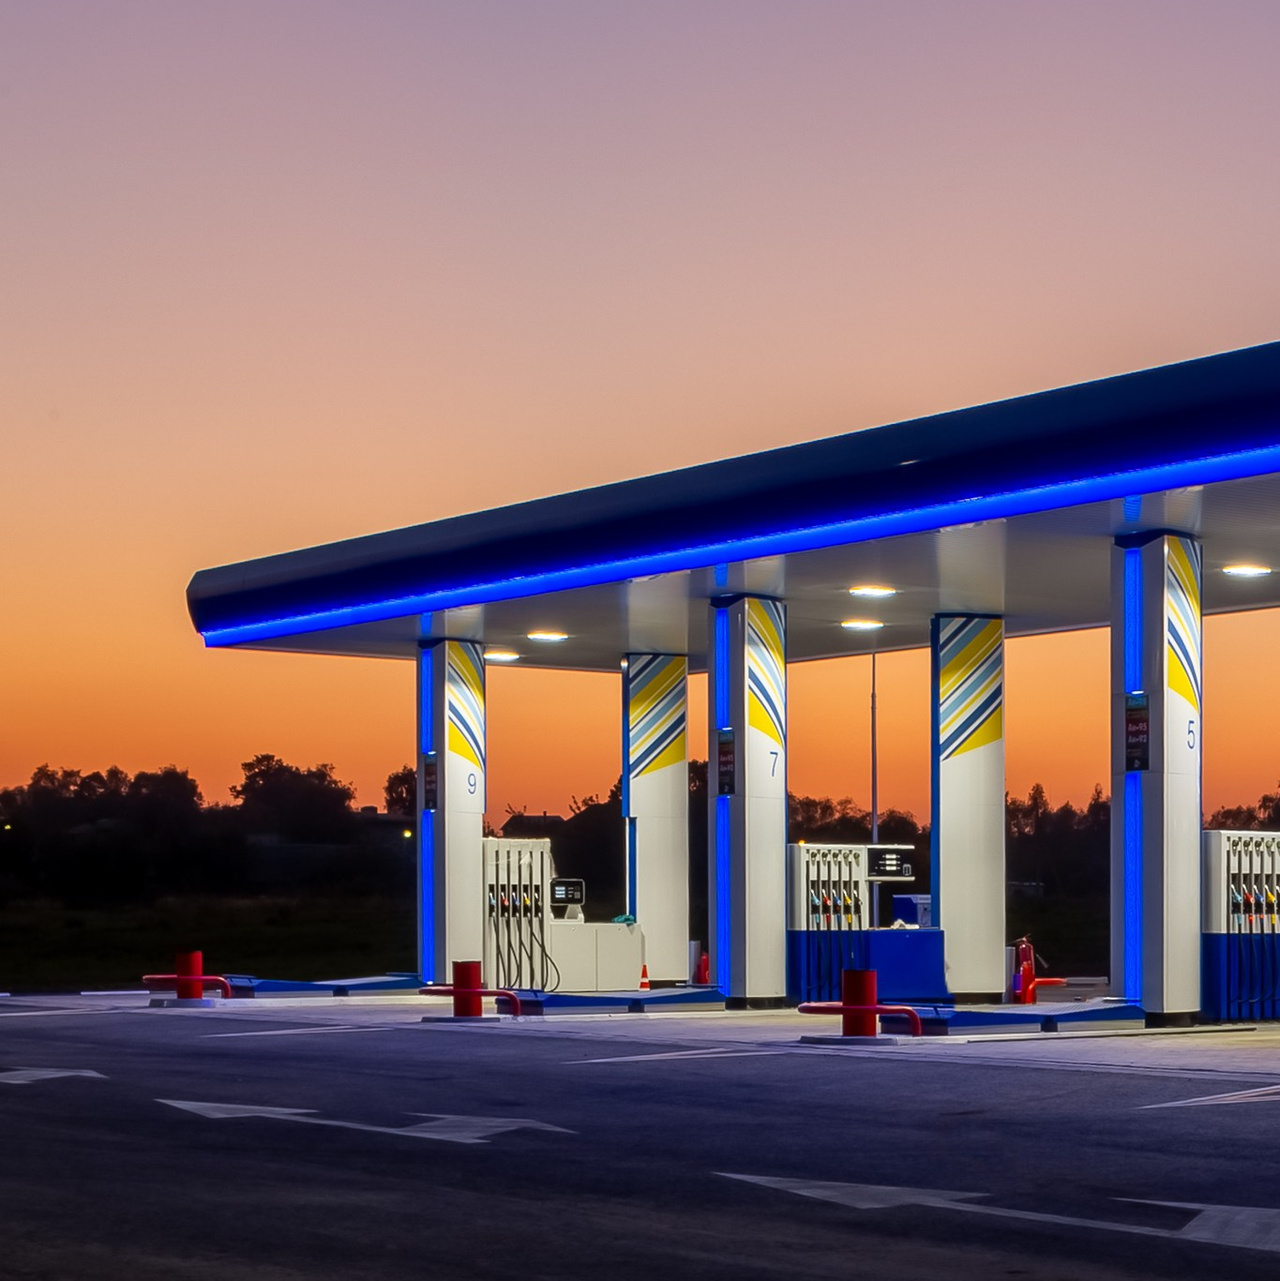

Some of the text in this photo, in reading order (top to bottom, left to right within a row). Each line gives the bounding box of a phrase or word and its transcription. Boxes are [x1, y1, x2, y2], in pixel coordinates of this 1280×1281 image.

[1187, 720, 1196, 749] 5
[769, 751, 779, 777] 7
[467, 773, 477, 794] 9
